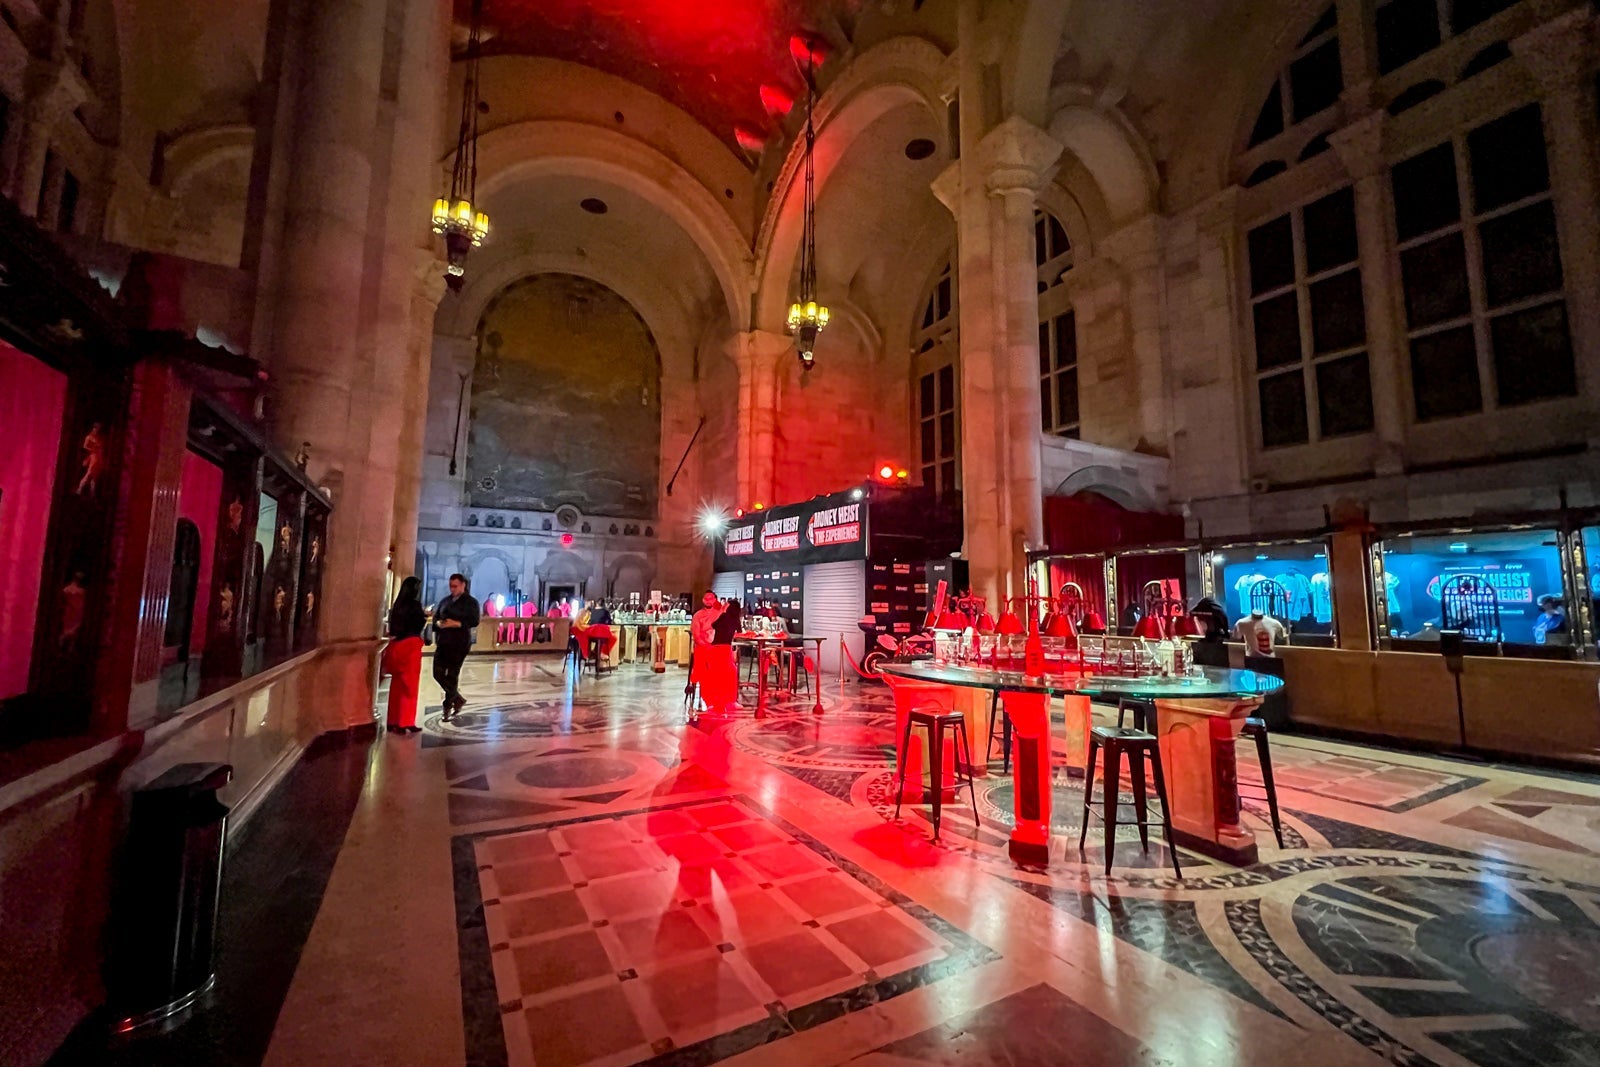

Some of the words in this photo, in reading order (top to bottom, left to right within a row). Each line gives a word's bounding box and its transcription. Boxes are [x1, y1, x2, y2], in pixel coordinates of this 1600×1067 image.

[814, 508, 838, 528] MONEY
[838, 504, 860, 523] HEIST
[765, 519, 783, 536] MONEY
[783, 516, 799, 533] HEIST
[815, 530, 825, 545] THE
[824, 526, 858, 542] EXPERIENCE
[774, 536, 798, 549] EXPERIENCE
[1490, 573, 1530, 588] HEIST
